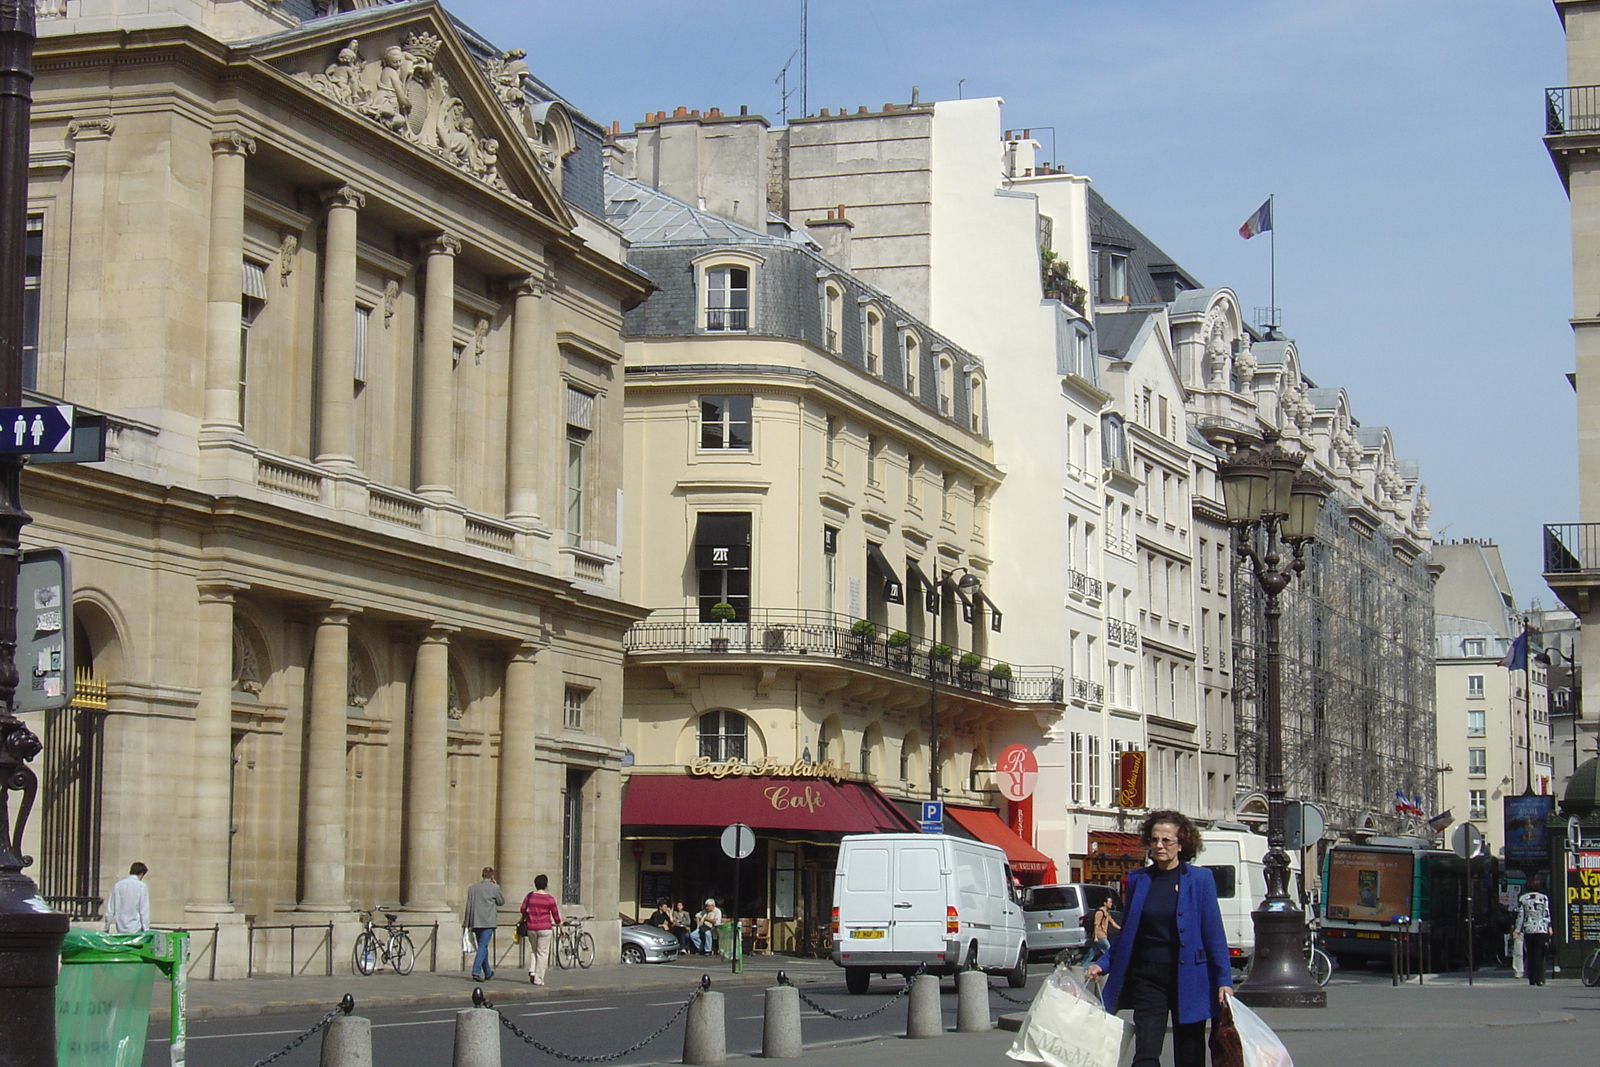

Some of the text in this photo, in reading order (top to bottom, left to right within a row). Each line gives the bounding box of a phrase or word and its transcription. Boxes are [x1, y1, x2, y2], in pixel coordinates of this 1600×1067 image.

[688, 755, 744, 779] Café
[751, 756, 825, 778] Palais
[1004, 748, 1027, 773] R
[1121, 754, 1142, 807] Restaurant
[764, 786, 825, 813] Café
[927, 805, 937, 819] P
